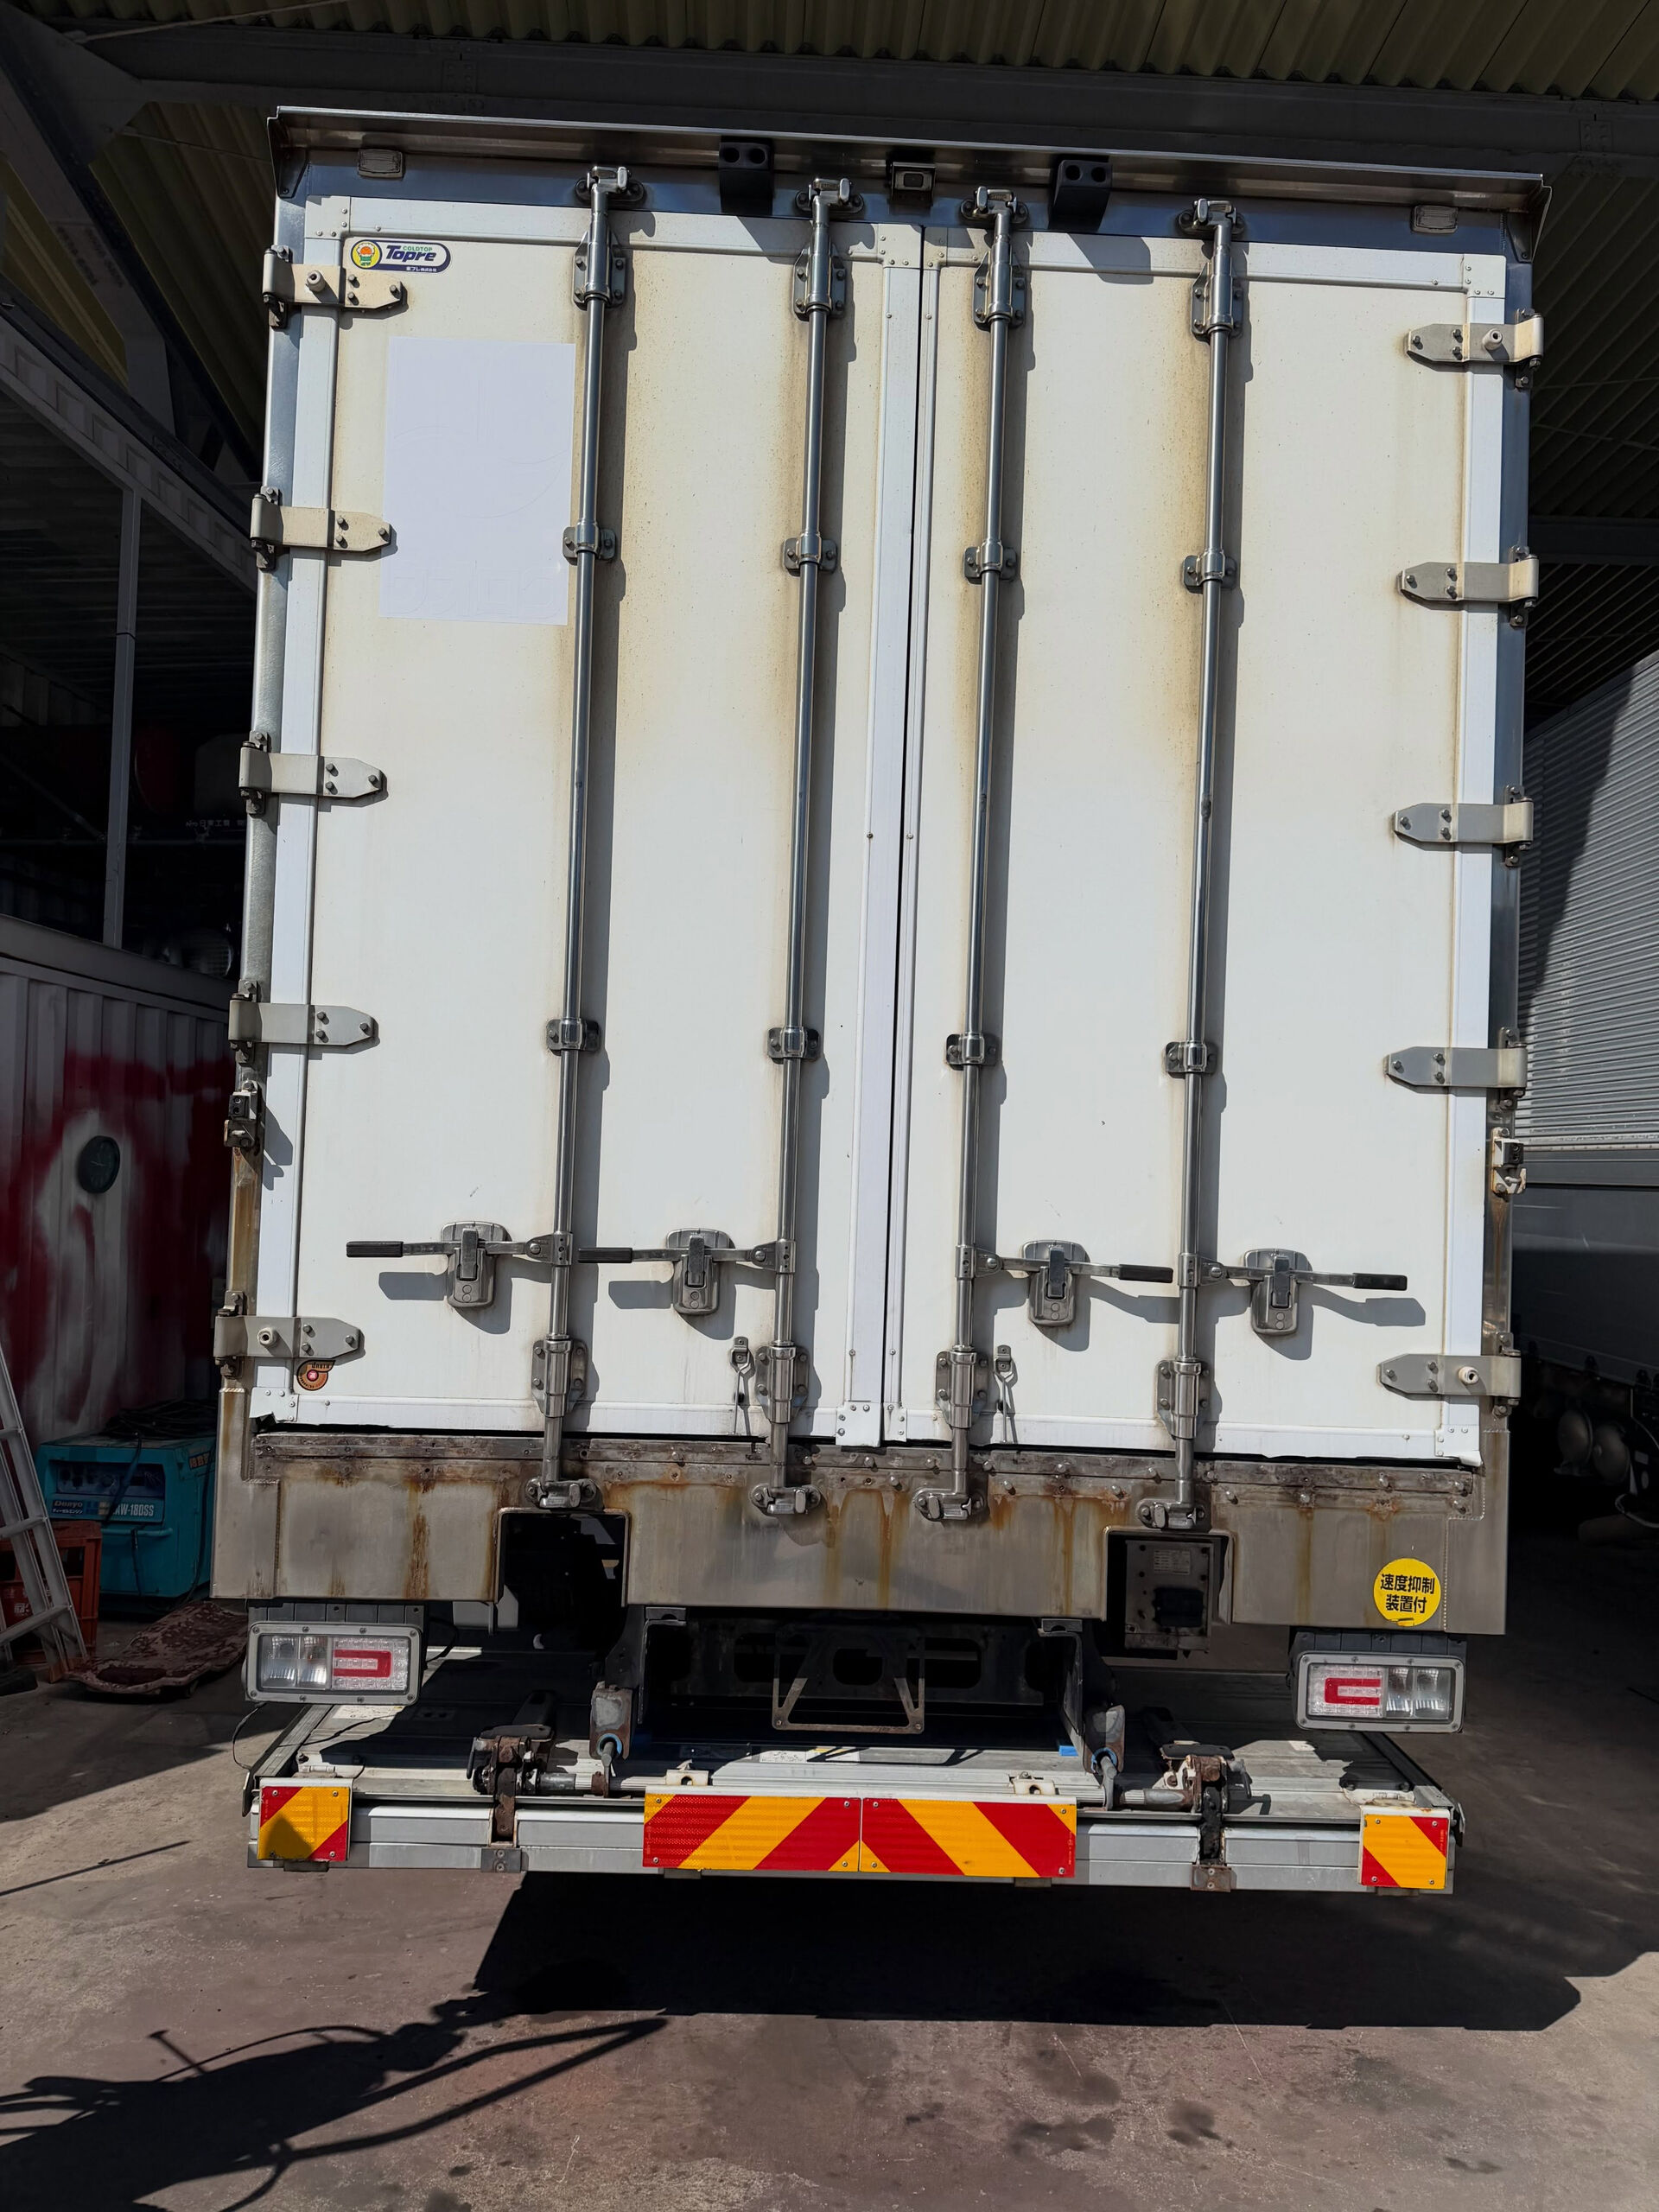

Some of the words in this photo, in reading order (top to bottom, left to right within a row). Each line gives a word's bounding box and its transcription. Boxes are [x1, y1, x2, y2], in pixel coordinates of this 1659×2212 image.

[385, 245, 437, 263] Topre
[112, 1503, 155, 1516] AW-180SS
[1380, 1573, 1435, 1594] 速度抑制
[1385, 1594, 1427, 1613] 装置付
